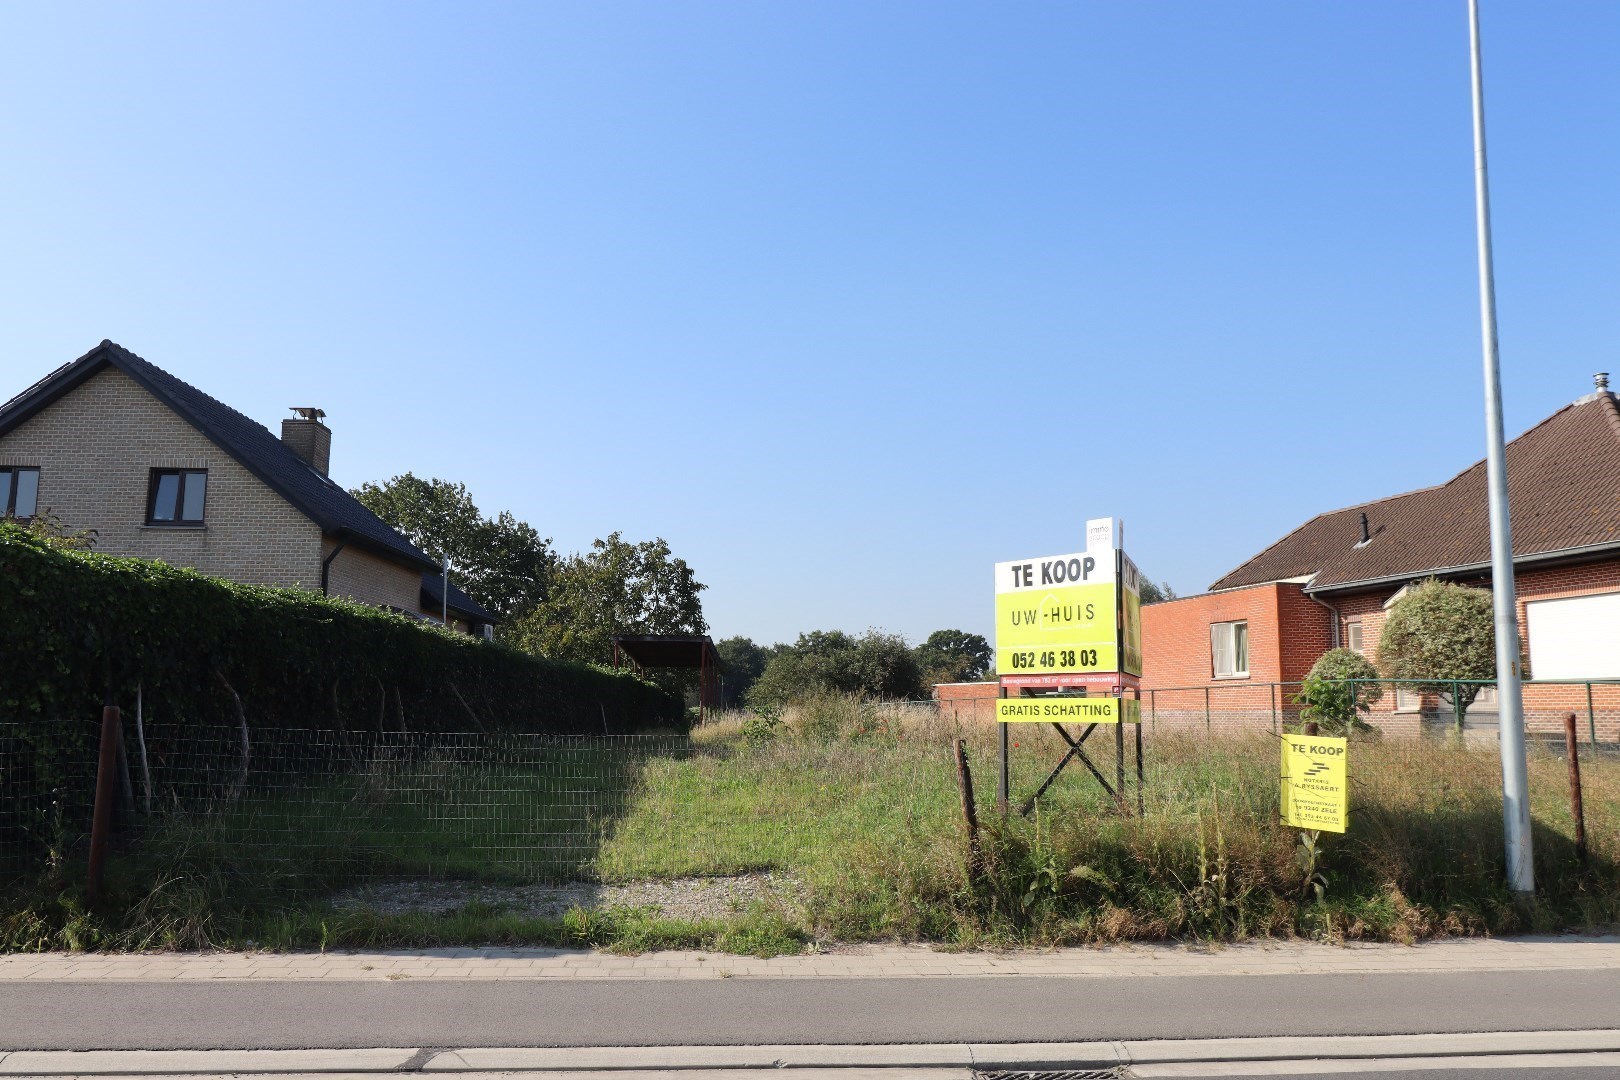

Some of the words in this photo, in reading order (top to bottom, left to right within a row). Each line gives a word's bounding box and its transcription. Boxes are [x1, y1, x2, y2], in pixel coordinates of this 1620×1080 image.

[1011, 564, 1033, 588] TE
[1041, 557, 1095, 585] KOOP
[1012, 652, 1035, 669] 052
[1040, 651, 1055, 668] 46
[1060, 650, 1075, 667] 38
[1080, 649, 1097, 667] 03
[1072, 676, 1086, 684] open
[1086, 675, 1117, 684] bebouwing
[1001, 705, 1040, 716] GRATIS
[1044, 704, 1111, 716] SCHATTING
[1291, 743, 1306, 753] TE
[1309, 745, 1344, 756] KOOP
